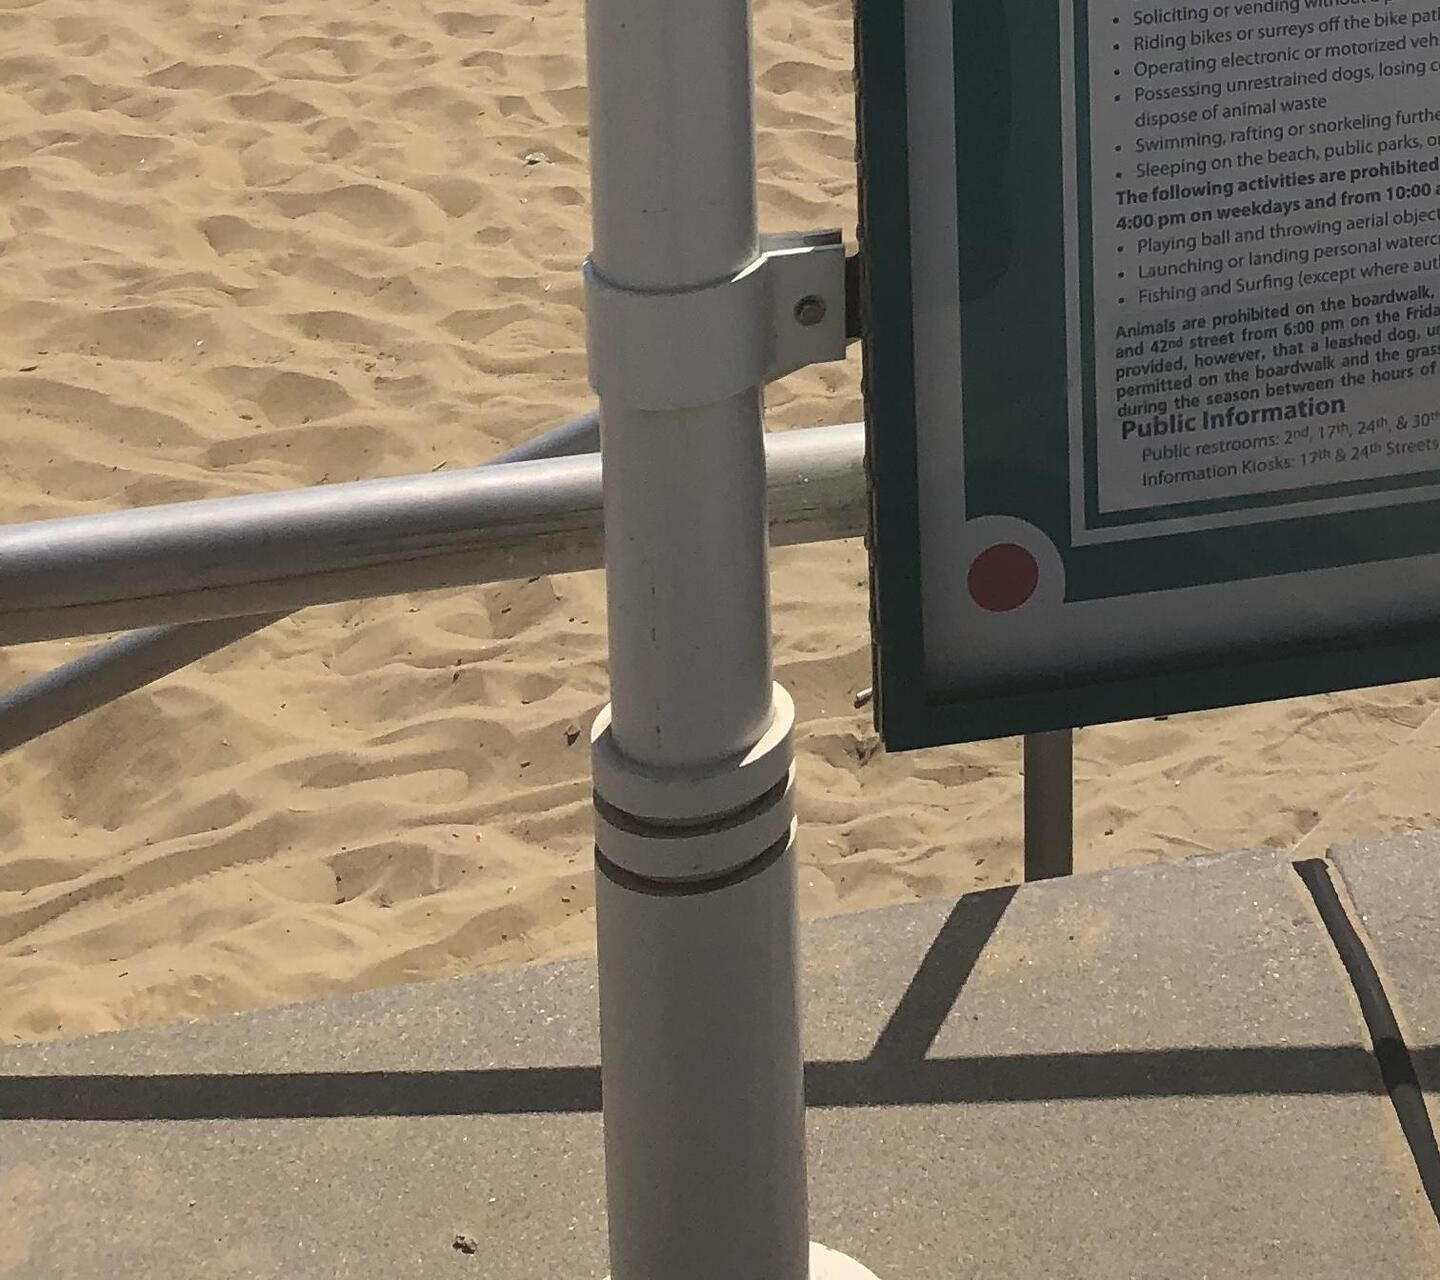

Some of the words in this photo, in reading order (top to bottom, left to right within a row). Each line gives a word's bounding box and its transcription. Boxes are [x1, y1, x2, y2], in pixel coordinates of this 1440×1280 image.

[1133, 6, 1209, 26] Soliciting
[1212, 5, 1230, 19] or
[1115, 188, 1148, 206] The
[1151, 180, 1234, 202] following
[1237, 171, 1316, 193] activities
[1319, 169, 1346, 185] are
[1350, 155, 1440, 185] prohibited
[1121, 413, 1196, 441] Public
[1202, 395, 1346, 431] Information
[1142, 442, 1191, 463] Public
[1195, 433, 1281, 458] restrooms:
[1283, 424, 1313, 446] 2nd,
[1320, 421, 1353, 440] 17th,
[1357, 416, 1392, 436] 24th,
[1395, 414, 1409, 432] &
[1142, 464, 1238, 488] Information
[1241, 455, 1295, 475] Kiosks:
[1300, 447, 1331, 466] 17th
[1334, 447, 1346, 463] &
[1350, 440, 1382, 462] 24th
[1386, 438, 1440, 457] Streets
